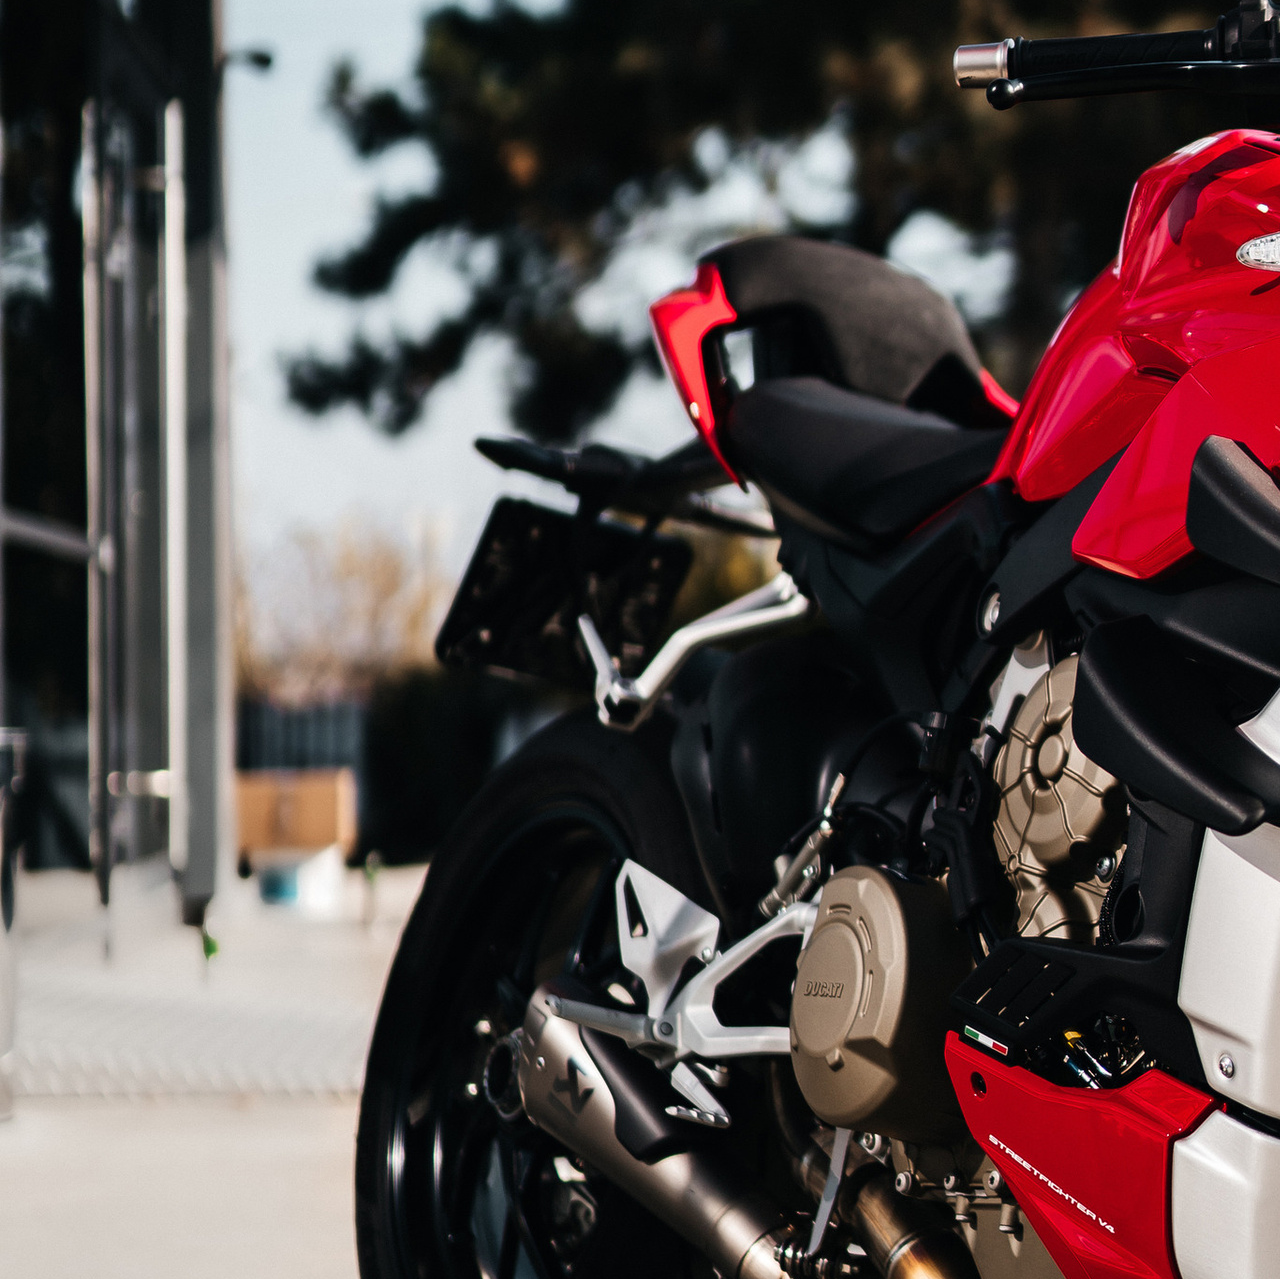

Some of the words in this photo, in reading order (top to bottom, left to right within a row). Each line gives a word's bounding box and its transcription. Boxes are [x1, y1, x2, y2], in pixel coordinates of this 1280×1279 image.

[803, 980, 845, 999] DUCATI
[988, 1133, 1097, 1221] STREETFIGHTER
[1098, 1217, 1116, 1234] V4
